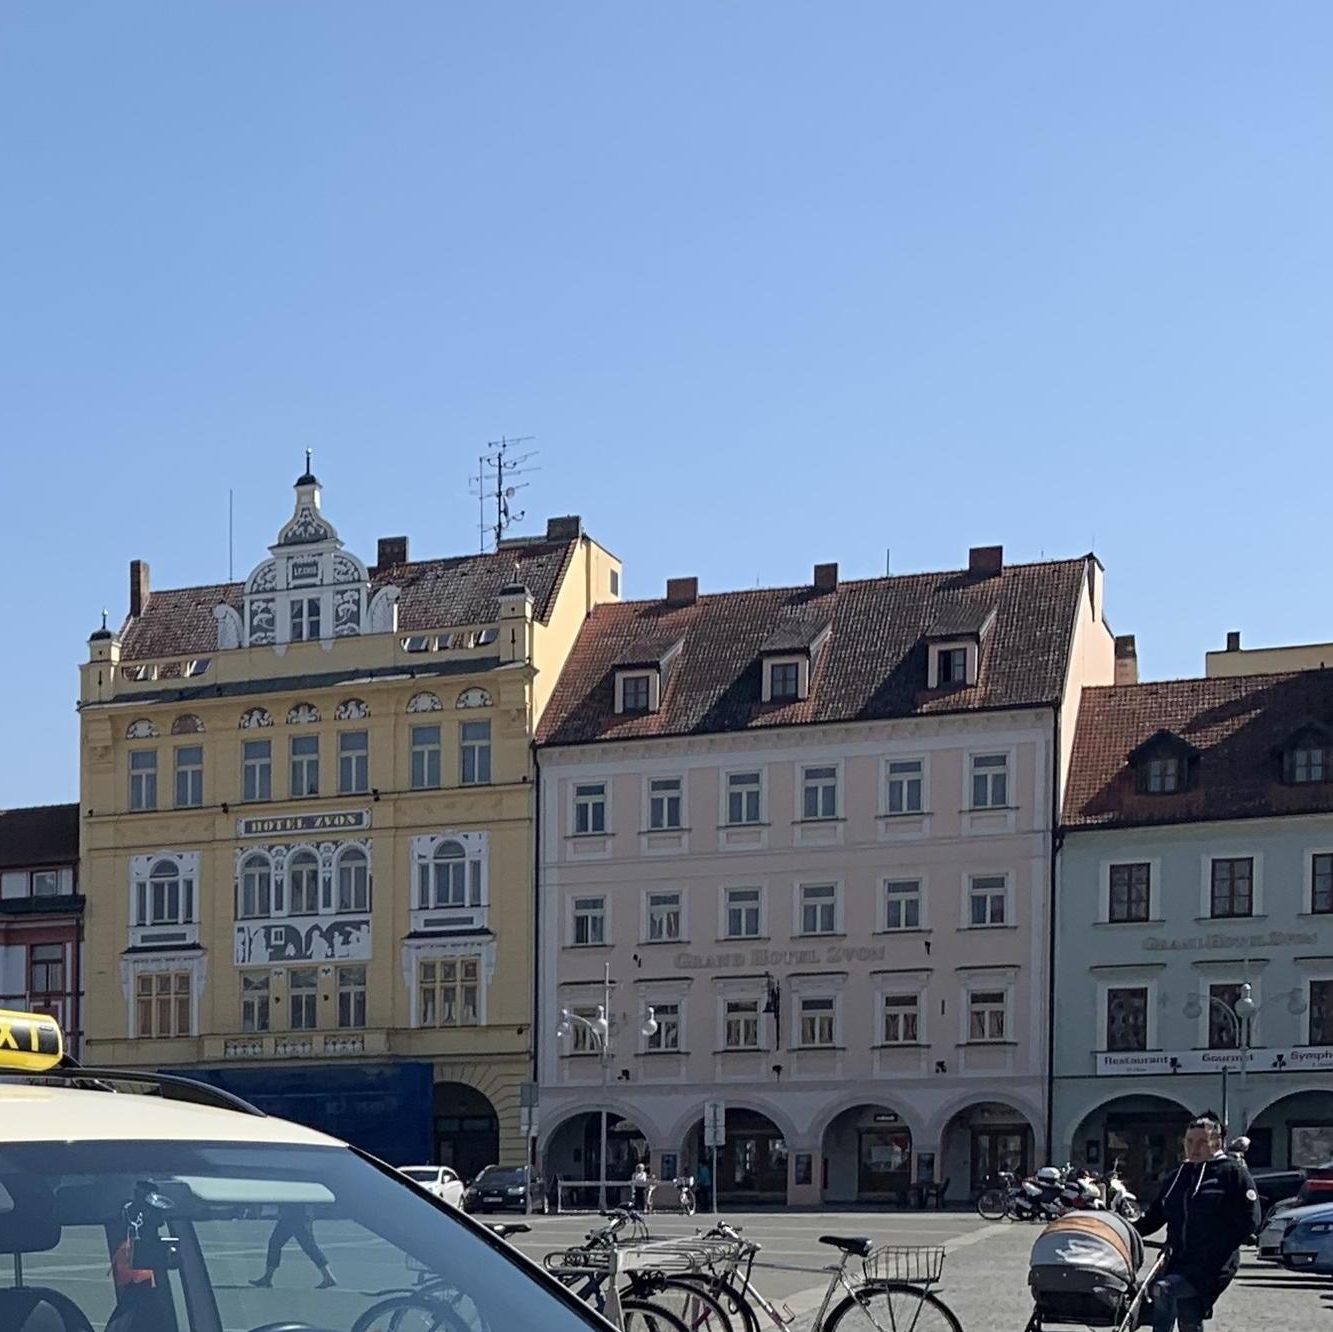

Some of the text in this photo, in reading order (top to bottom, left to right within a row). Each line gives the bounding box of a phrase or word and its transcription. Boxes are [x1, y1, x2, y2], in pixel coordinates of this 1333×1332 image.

[251, 814, 357, 832] HOTEL ZVON
[750, 948, 821, 967] HOTEL
[826, 945, 886, 963] ZVON
